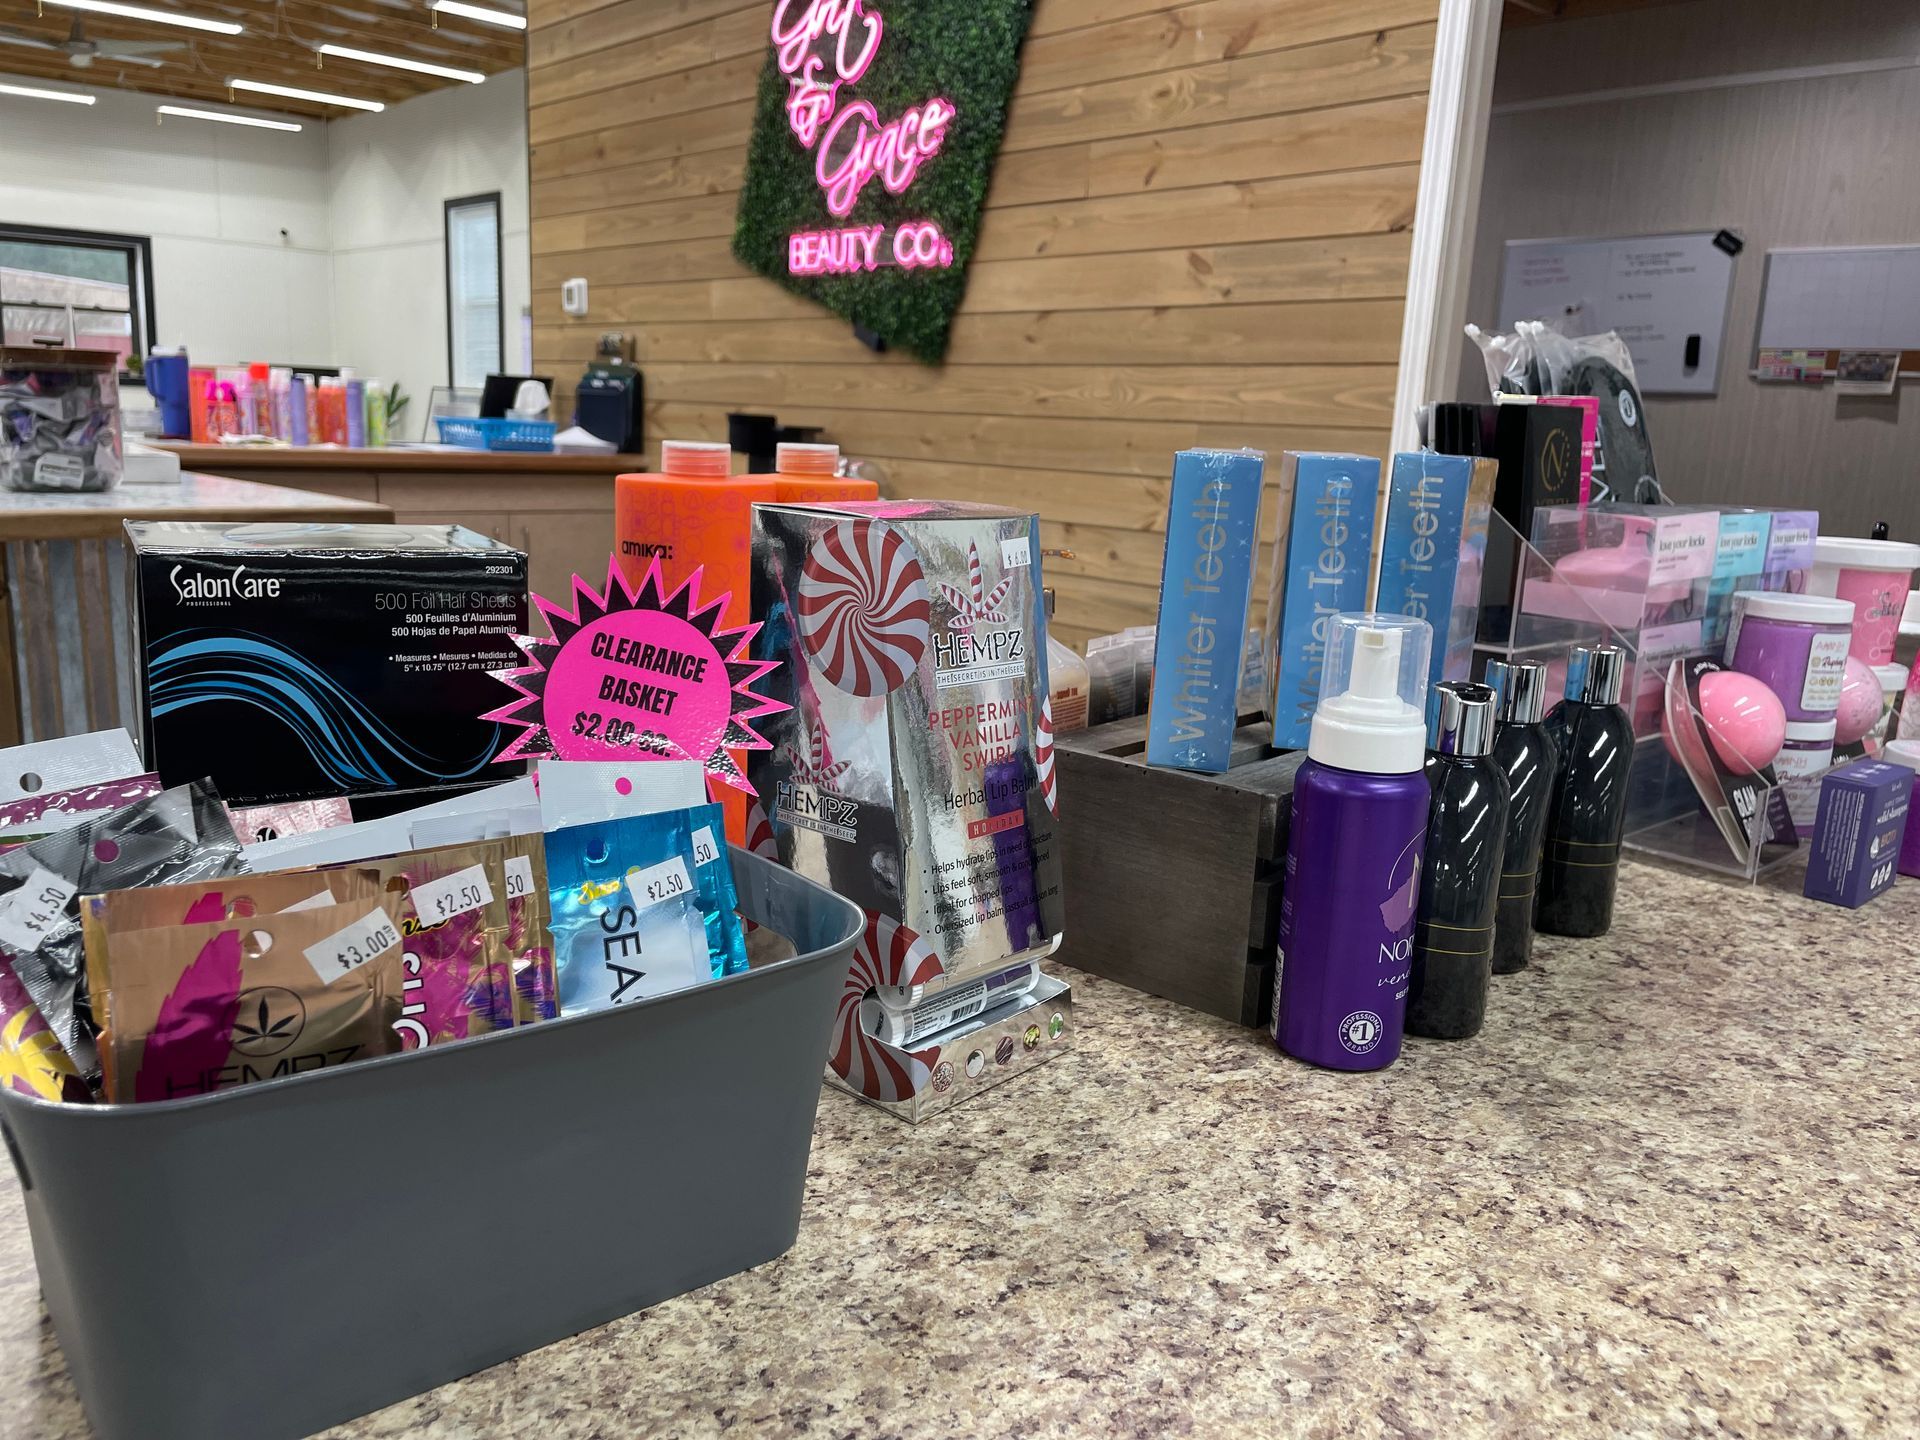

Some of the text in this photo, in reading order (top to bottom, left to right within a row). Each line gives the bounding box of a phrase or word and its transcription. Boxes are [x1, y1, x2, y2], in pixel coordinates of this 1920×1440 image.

[816, 99, 954, 214] Grace
[789, 225, 884, 273] BEAUTY
[1308, 477, 1352, 589] Teeth
[1400, 476, 1444, 572] Teeth
[621, 541, 673, 560] amika:
[485, 566, 513, 574] 292301
[375, 591, 516, 610] 500 Foil Half Sheets
[1169, 483, 1232, 744] Whiter Teeth
[391, 625, 517, 638] 500 Hojas de Papel Aluminio
[405, 612, 516, 623] 500 Feuilles d'Aluminium
[395, 651, 518, 662] Measures Mesures Medidas de
[591, 632, 708, 683] CLEARANCE
[933, 629, 1024, 667] HEMPZ
[448, 662, 466, 672] (12.7
[487, 661, 503, 669] 27.3
[504, 661, 518, 669] cm)
[598, 675, 678, 716] BASKET
[572, 711, 635, 746] $2.00
[949, 722, 1022, 750] VANILLA
[963, 745, 1015, 772] SWIRL
[777, 781, 858, 826] HEMPZ
[944, 774, 1038, 811] Herbal Lip Balm
[931, 861, 955, 875] Helps
[956, 854, 985, 870] hydrate
[985, 849, 999, 862] lips
[648, 873, 683, 901] $2.50
[932, 882, 949, 895] Lips
[951, 877, 967, 889] feel
[967, 873, 984, 886] soft,
[985, 866, 1011, 880] smooth
[24, 887, 67, 932] $4.50
[436, 885, 481, 916] $2.50
[934, 898, 954, 915] Ideal
[956, 898, 968, 909] for
[969, 888, 1000, 905] chapped
[934, 915, 974, 935] Oversized
[975, 910, 985, 925] lip
[986, 906, 1003, 920] balm
[337, 931, 389, 969] $3.00
[600, 905, 646, 1003] SEA
[1342, 1013, 1381, 1034] PROFESSIONAL
[1351, 1022, 1369, 1041] #1
[1346, 1041, 1374, 1052] BRAND
